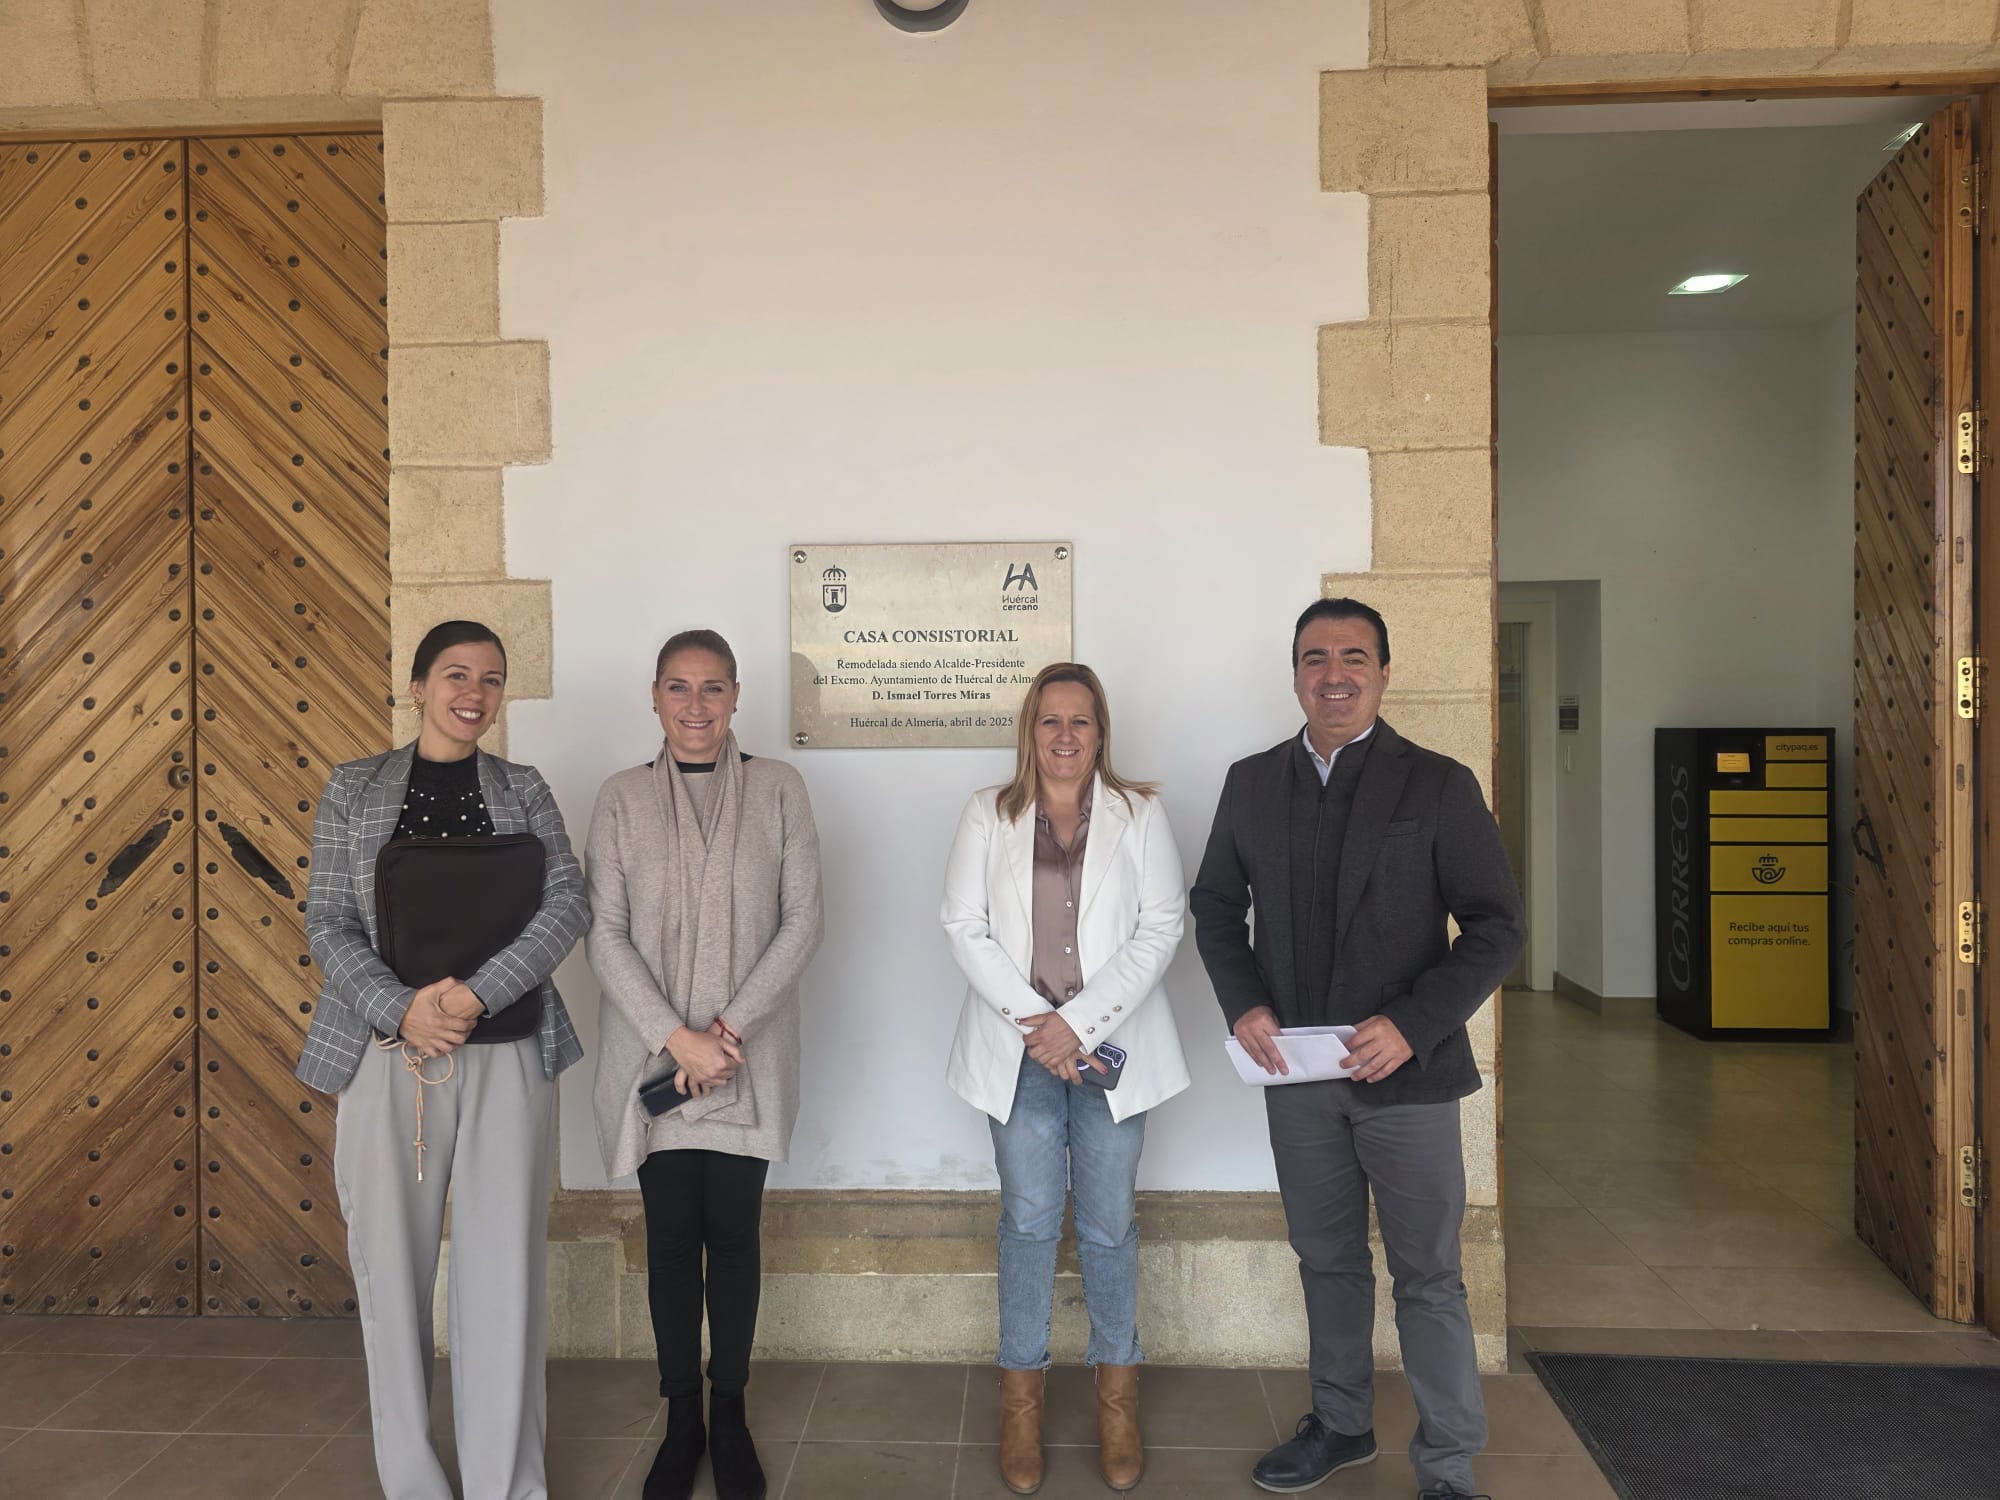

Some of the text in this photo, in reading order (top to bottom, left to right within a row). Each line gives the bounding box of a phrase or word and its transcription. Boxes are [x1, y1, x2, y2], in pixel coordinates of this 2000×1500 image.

[843, 629, 1019, 643] CASA CONSISTORIAL
[837, 658, 1025, 669] Remodelada siendo Alcalde-Presidente
[813, 675, 828, 685] del
[831, 675, 868, 685] Excmo.
[870, 674, 938, 687] Ayuntamiento
[940, 674, 952, 684] de
[955, 674, 993, 684] Huércal
[996, 674, 1007, 684] de
[872, 690, 991, 700] D. Ismael Torres Miras
[850, 717, 888, 728] Huércal
[891, 717, 903, 728] de
[950, 716, 972, 727] abril
[975, 717, 987, 727] de
[990, 717, 1013, 727] 2025
[1668, 764, 1690, 992] CORREOS
[1729, 922, 1765, 932] Recibe
[1792, 923, 1810, 933] tus
[1727, 935, 1811, 947] compras online.
